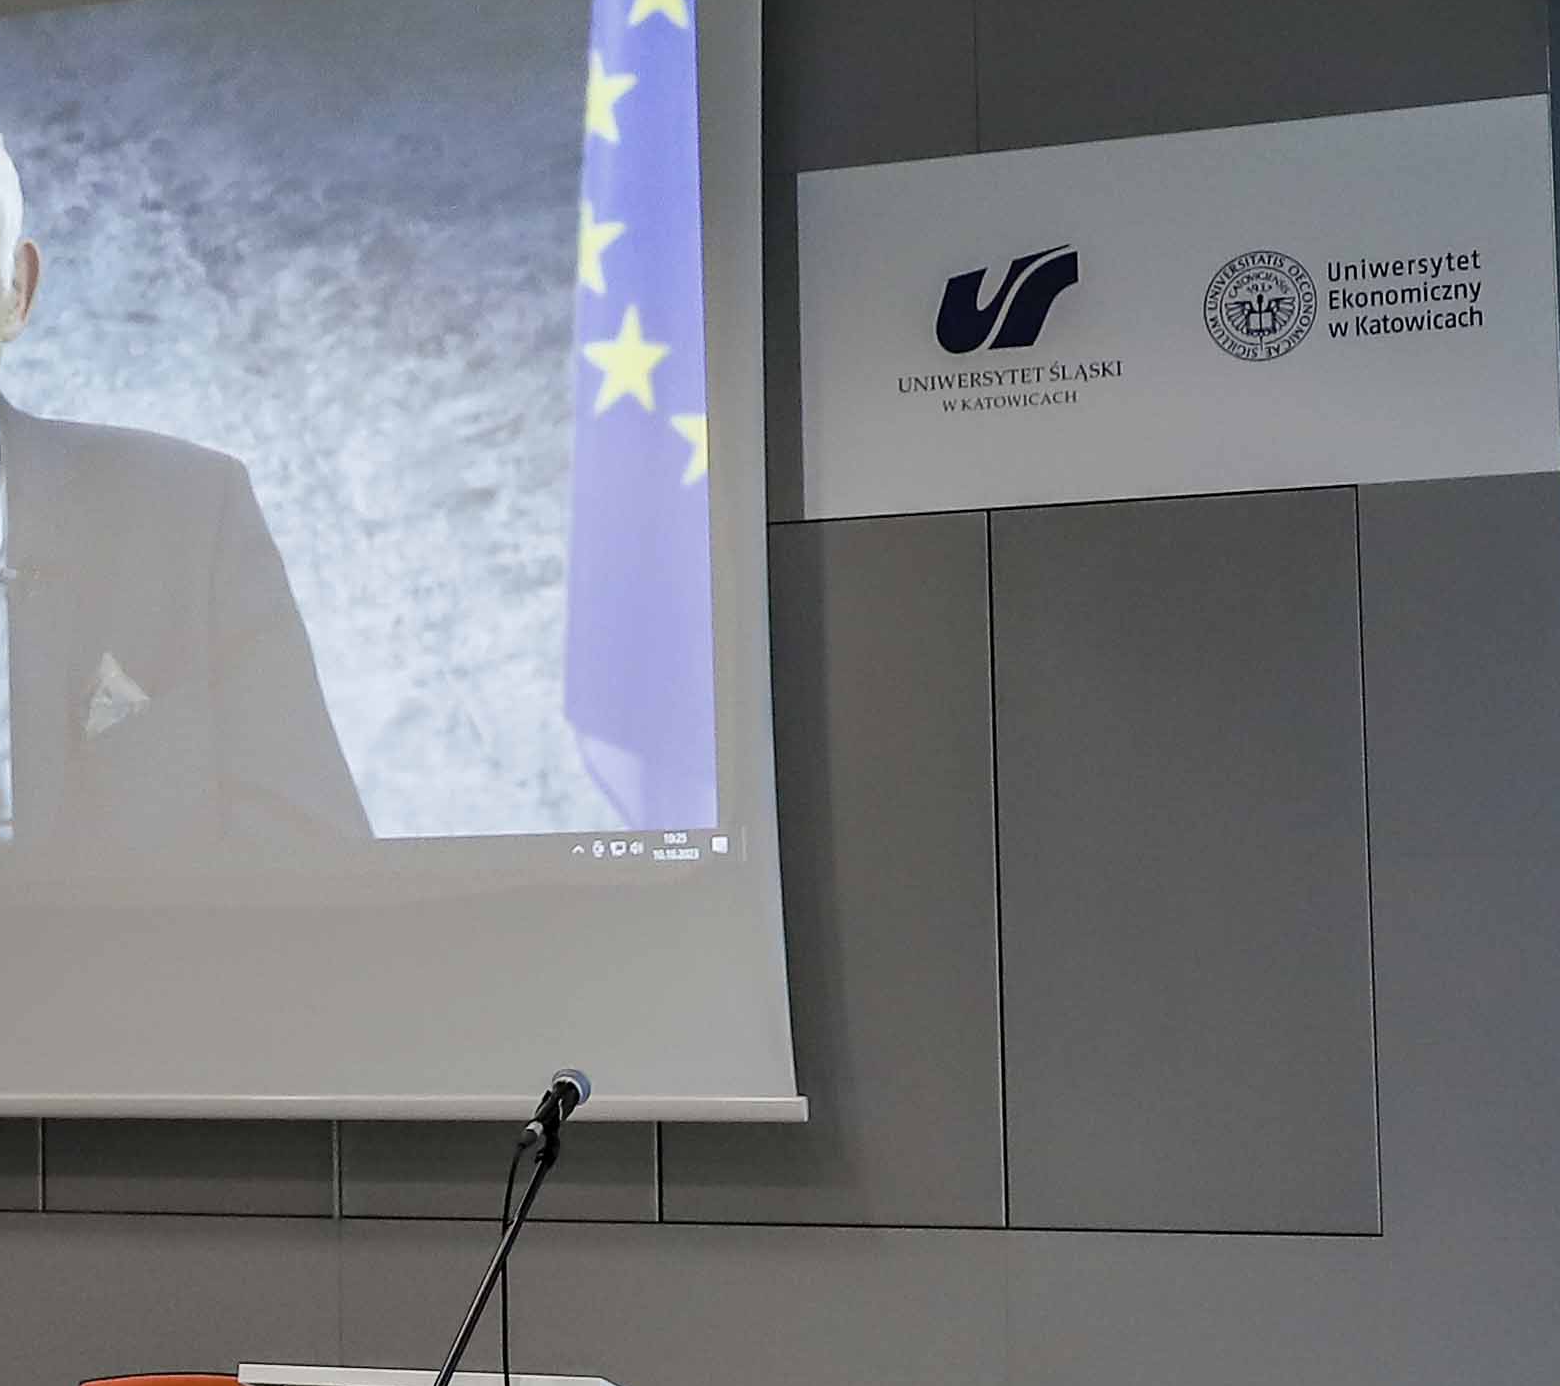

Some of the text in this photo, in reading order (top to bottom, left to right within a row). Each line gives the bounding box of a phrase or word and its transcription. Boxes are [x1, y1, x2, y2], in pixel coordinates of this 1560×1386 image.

[1328, 250, 1481, 281] Uniwersytet
[1329, 281, 1481, 310] Ekonomiczny
[1329, 306, 1483, 338] w Katowicach
[898, 360, 1123, 393] UNIWERSYTET ŚLĄSKI
[942, 391, 1077, 413] W KATOWICACH
